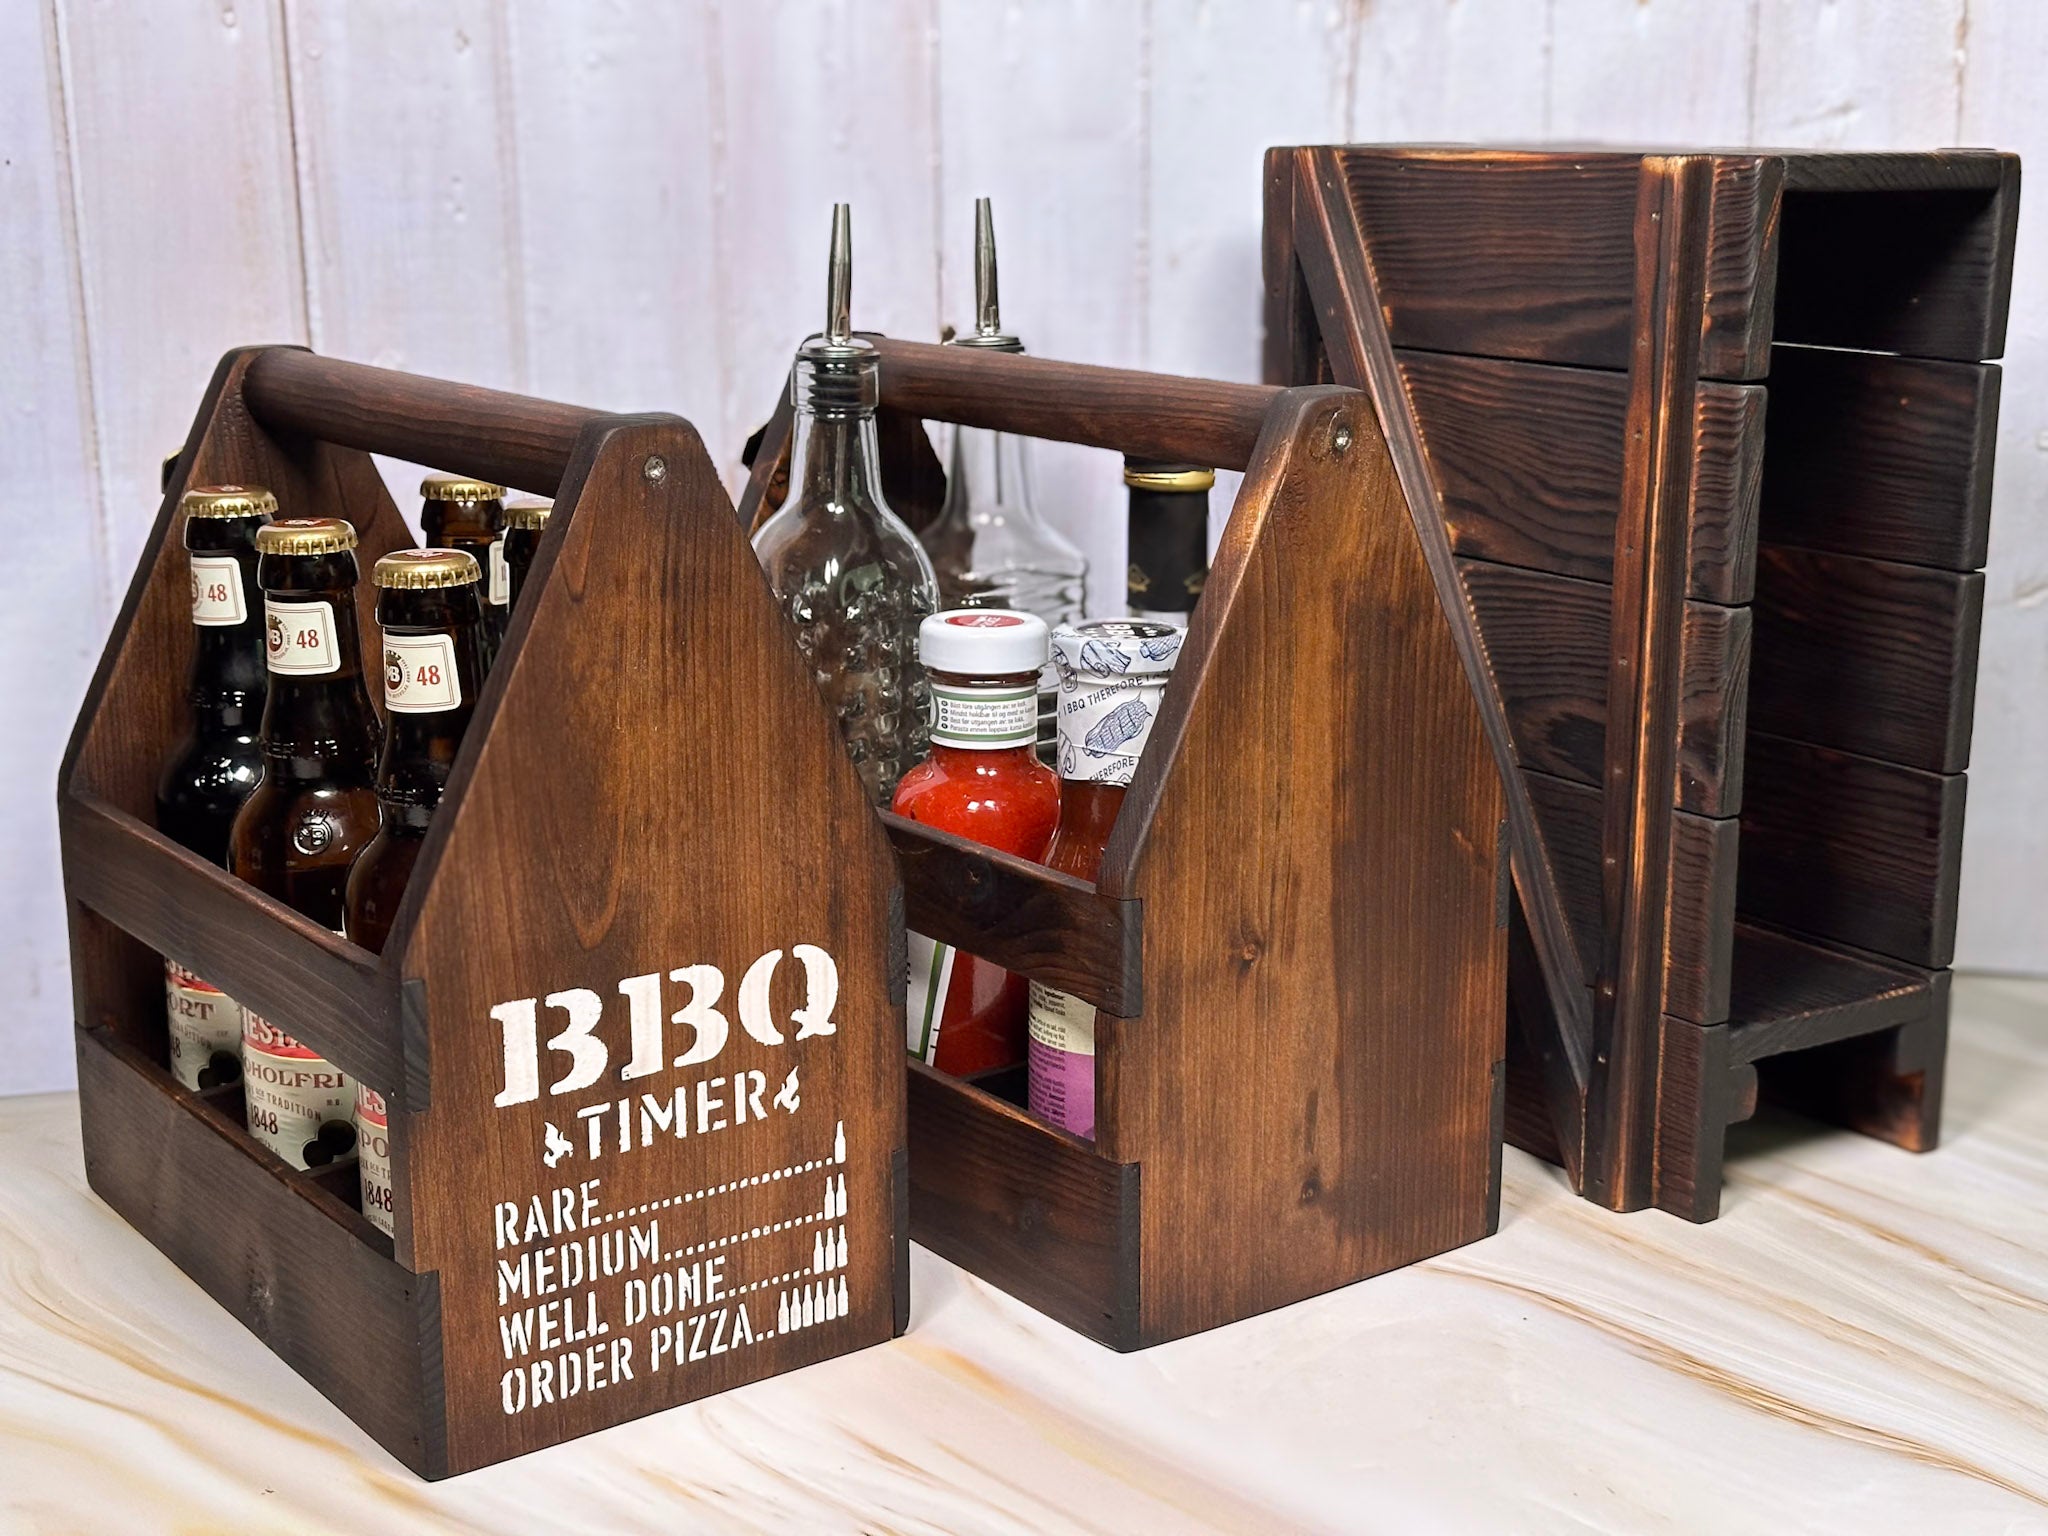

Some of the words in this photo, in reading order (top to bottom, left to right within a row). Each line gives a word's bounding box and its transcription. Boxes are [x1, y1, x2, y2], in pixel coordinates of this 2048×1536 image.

[208, 584, 227, 602] 48
[296, 629, 319, 649] 48
[417, 665, 441, 686] 48
[1067, 701, 1086, 714] BBQ
[1087, 676, 1143, 706] THEREFORE
[490, 944, 838, 1108] BBQ
[267, 1093, 322, 1122] TRADITION
[577, 1070, 768, 1162] TIMER
[364, 1177, 393, 1213] 1848
[499, 1291, 609, 1360] WELL
[500, 1338, 634, 1415] ORDER
